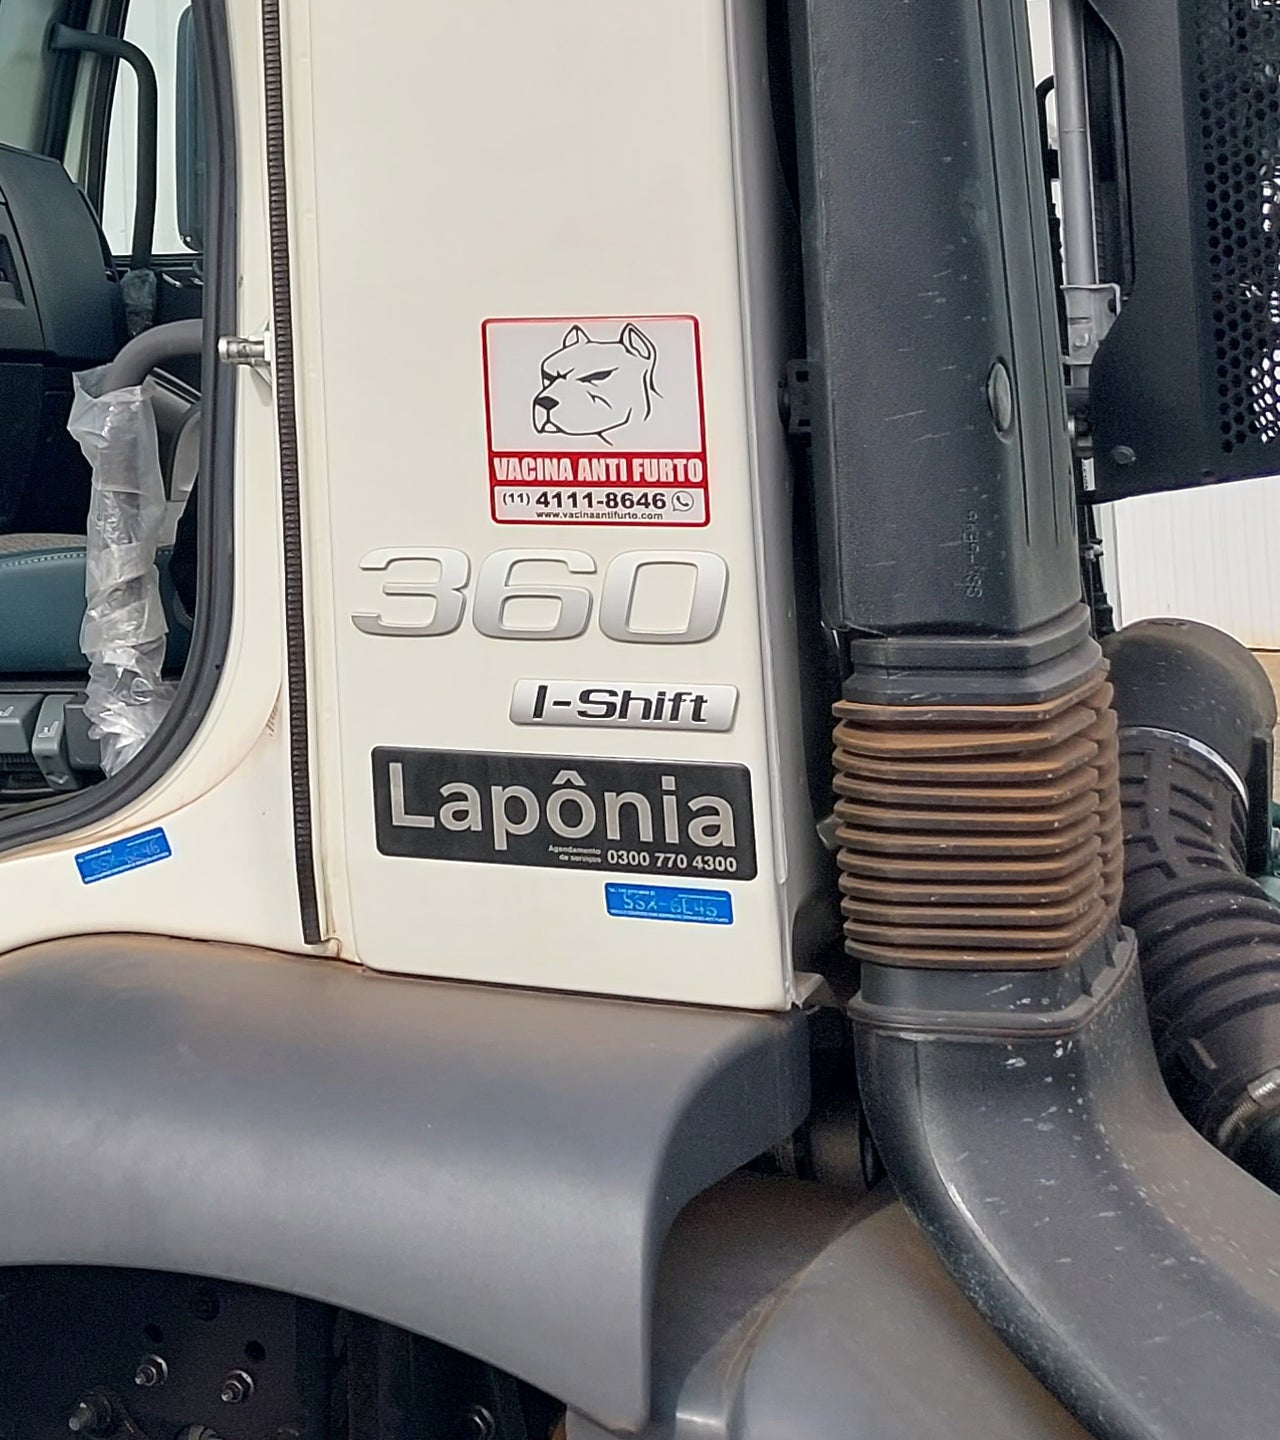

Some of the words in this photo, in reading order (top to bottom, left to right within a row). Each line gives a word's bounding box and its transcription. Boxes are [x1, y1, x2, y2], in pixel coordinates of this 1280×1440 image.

[493, 456, 573, 481] VACINA
[577, 457, 628, 481] ANTI
[632, 458, 703, 482] FURTO
[503, 492, 531, 506] (11)
[535, 490, 667, 509] 4111-8646
[535, 510, 663, 521] www.vacinaantifurto.com
[350, 546, 729, 644] 360
[532, 684, 709, 724] I-Shift
[388, 761, 737, 851] Lapônia
[607, 850, 650, 866] 0300
[654, 853, 688, 869] 770
[692, 855, 737, 872] 4300
